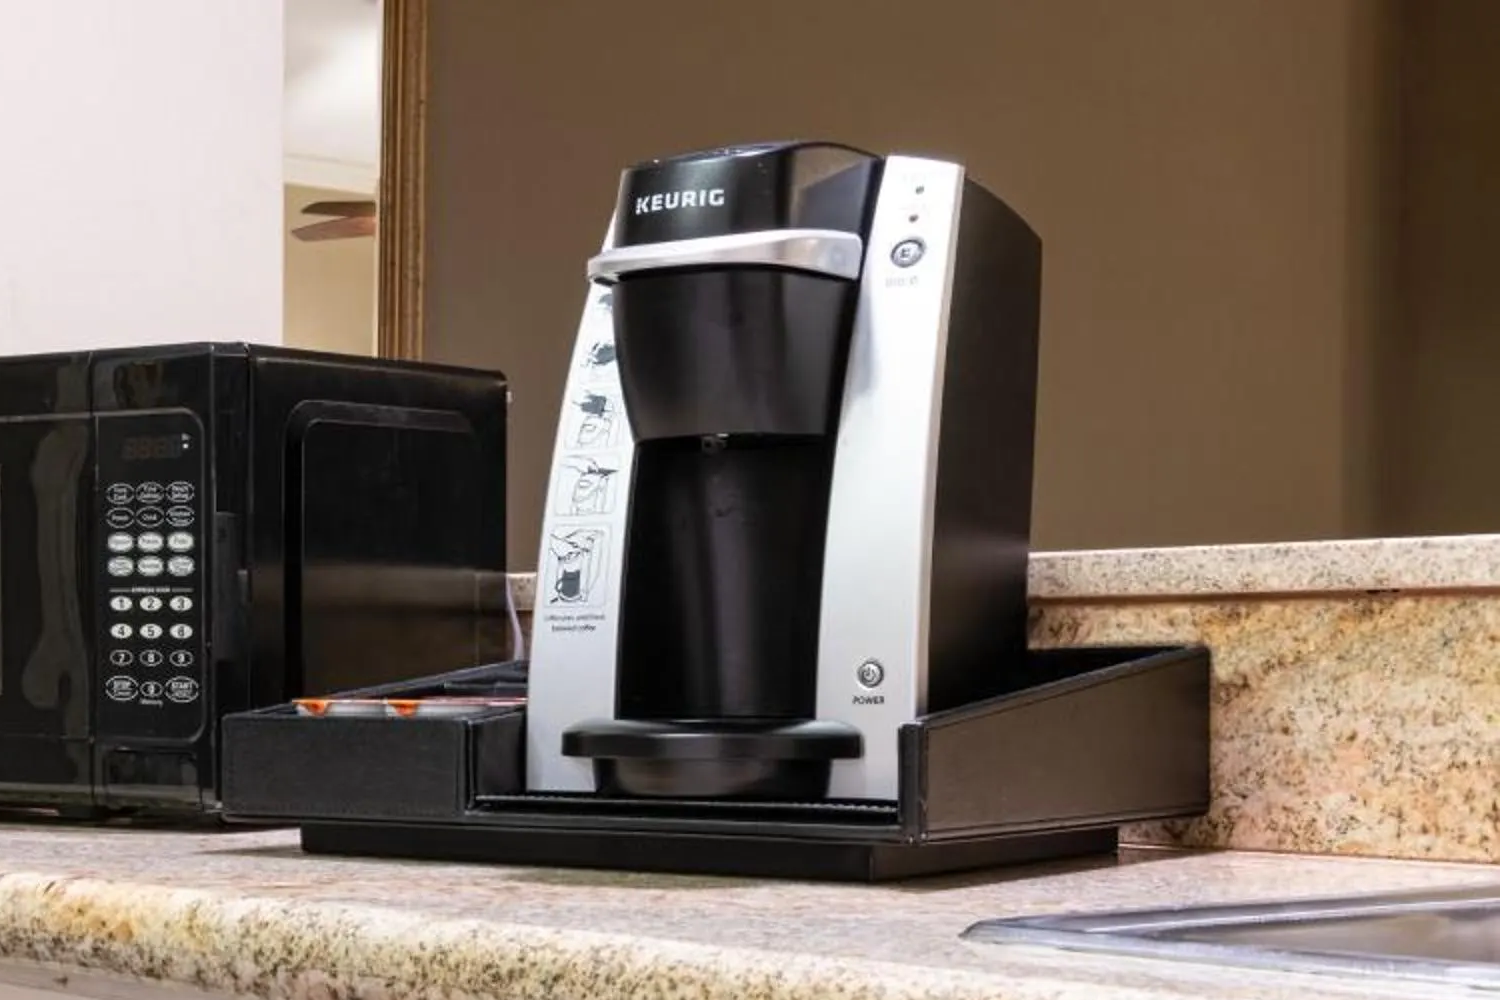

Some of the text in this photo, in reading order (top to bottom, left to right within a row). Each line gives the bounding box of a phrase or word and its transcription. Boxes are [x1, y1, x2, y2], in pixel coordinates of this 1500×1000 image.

[635, 188, 725, 215] KEURIG
[147, 598, 155, 609] 2
[177, 598, 185, 609] 3
[117, 626, 185, 637] 4 5 6
[117, 653, 185, 663] 7 8 9
[851, 695, 885, 705] POWER
